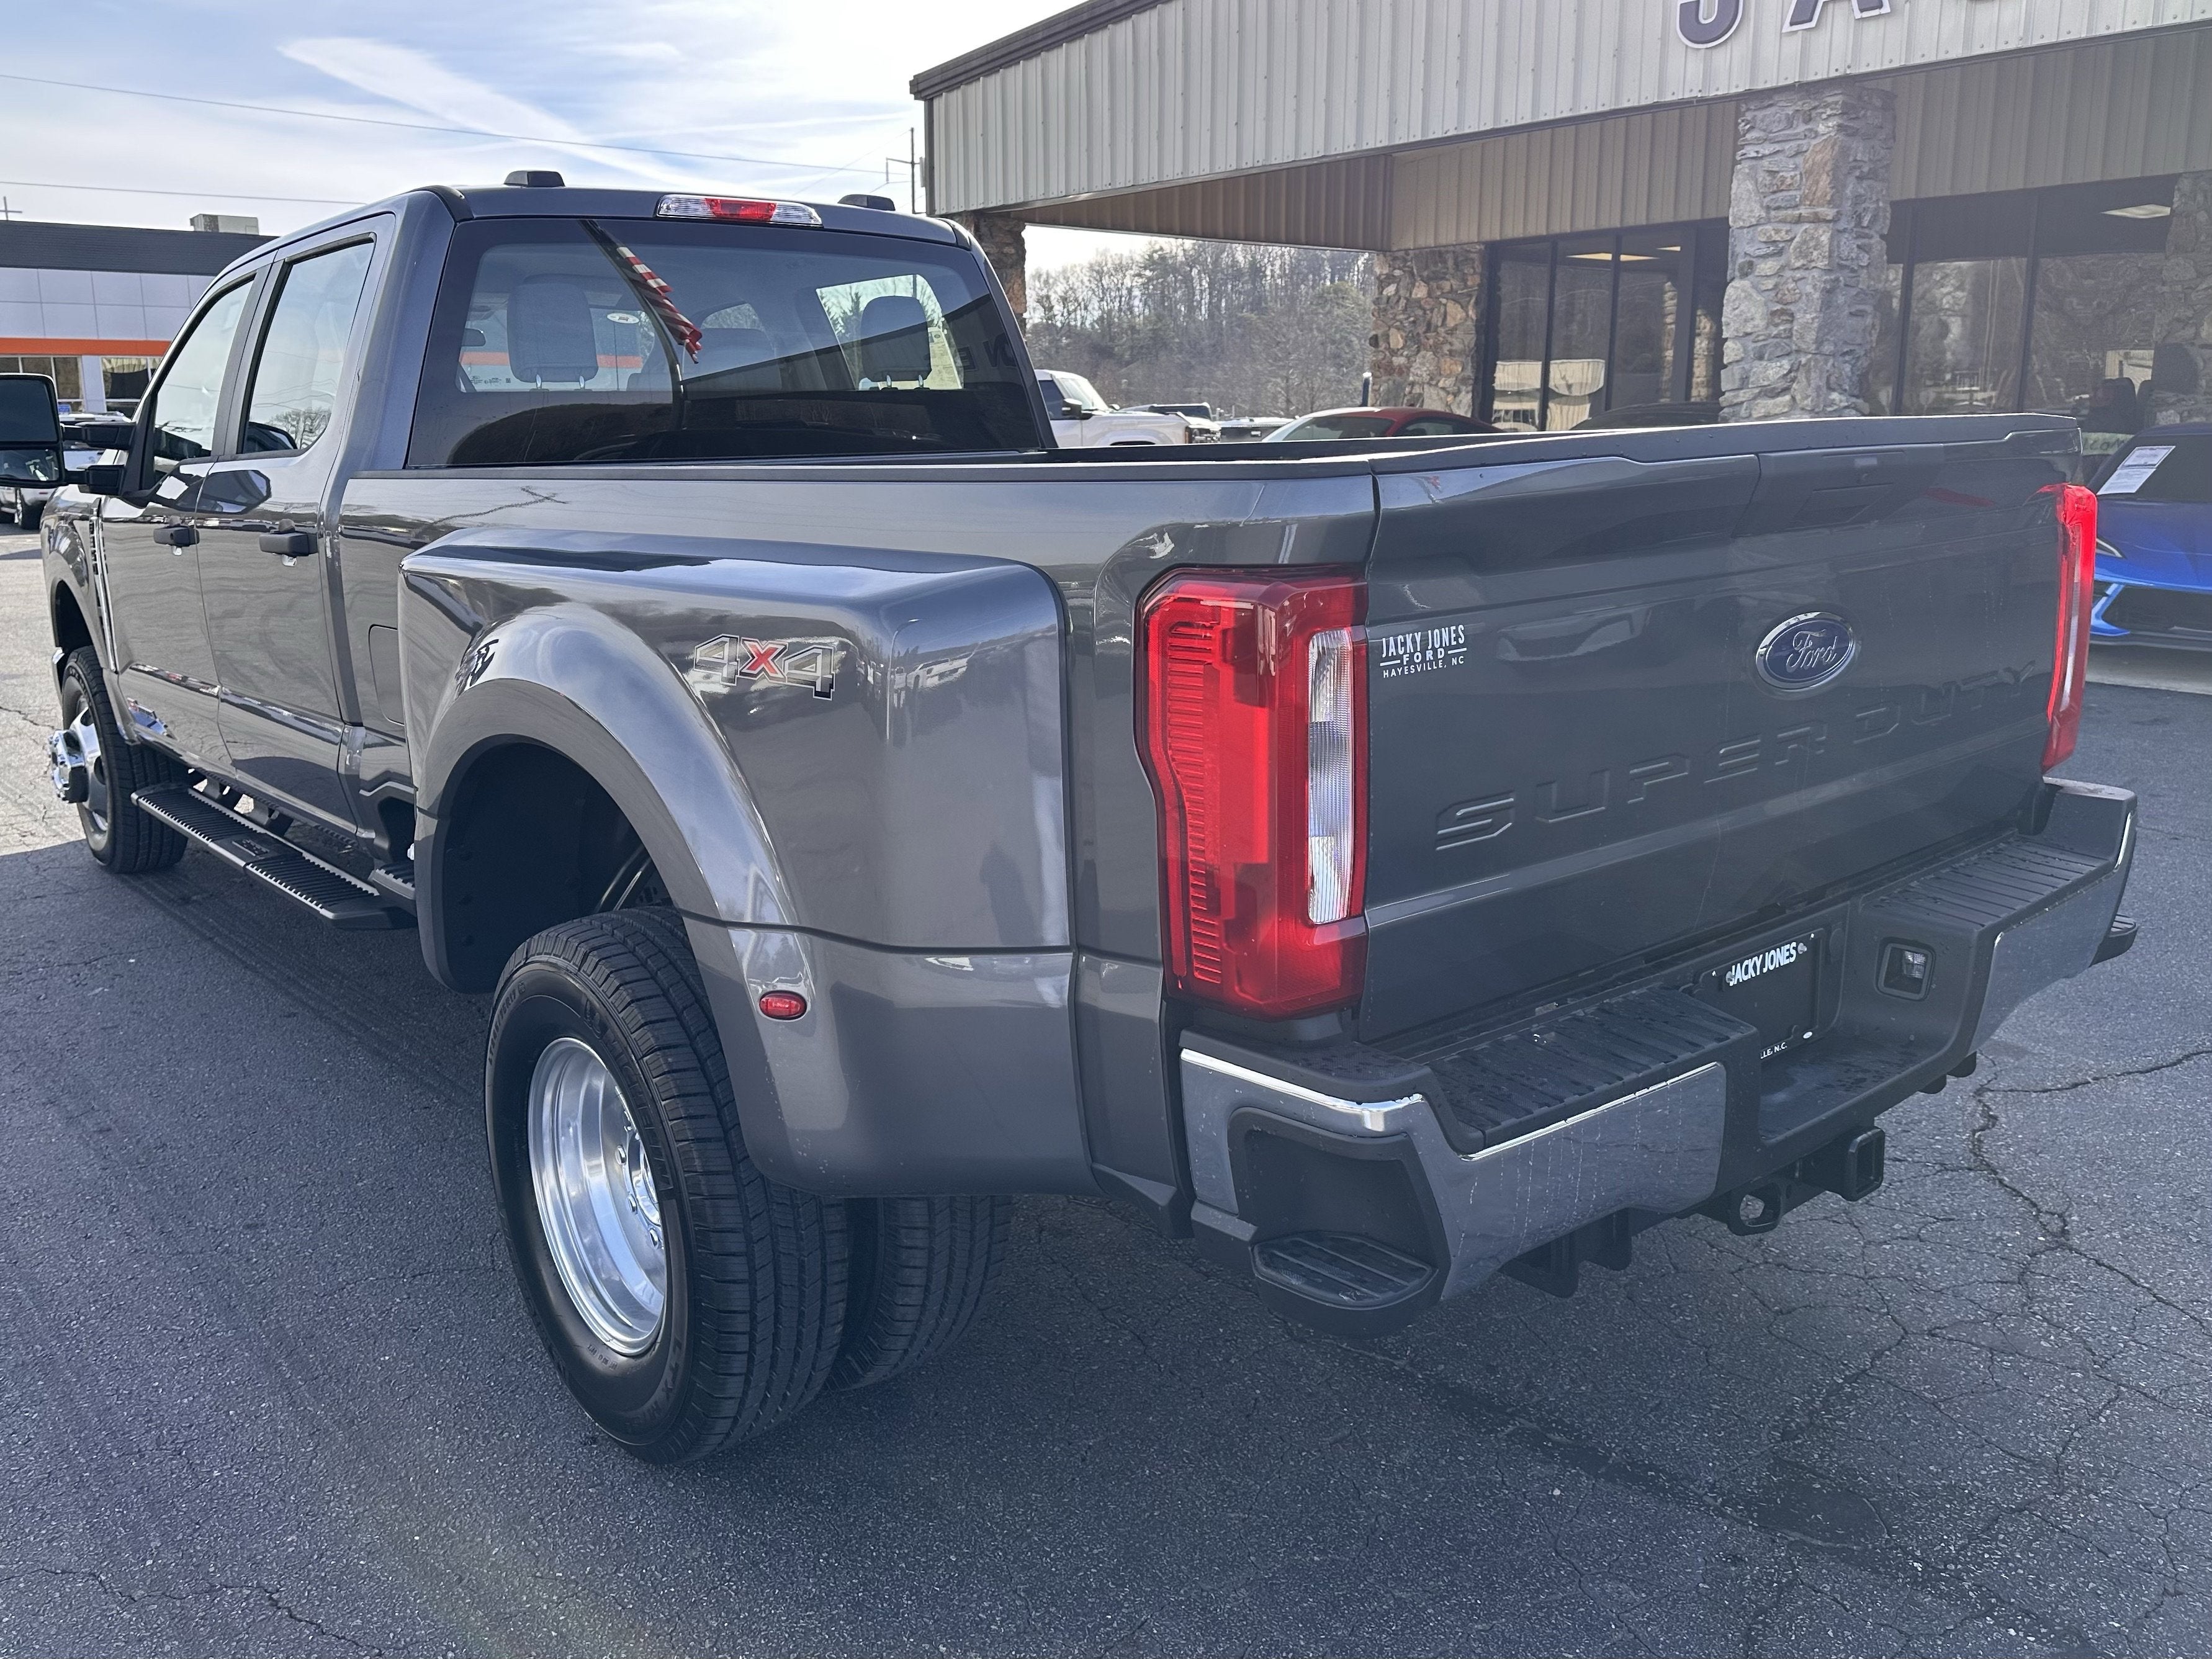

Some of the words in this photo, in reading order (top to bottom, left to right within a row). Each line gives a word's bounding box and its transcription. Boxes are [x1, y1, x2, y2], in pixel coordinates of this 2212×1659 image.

[1382, 632, 1421, 658] JACKY
[1427, 624, 1465, 650] JONES
[1403, 648, 1445, 665] FORD
[1786, 628, 1838, 673] Ford
[1383, 660, 1447, 678] HAYESVILLE,
[1452, 655, 1465, 666] NC
[1435, 720, 1828, 850] SUPER
[1853, 660, 2036, 745] DUTY
[1729, 955, 1763, 986] JACKY
[1763, 942, 1797, 973] JONES
[1774, 1042, 1788, 1053] N.C.
[603, 1027, 674, 1190] MICHELIN
